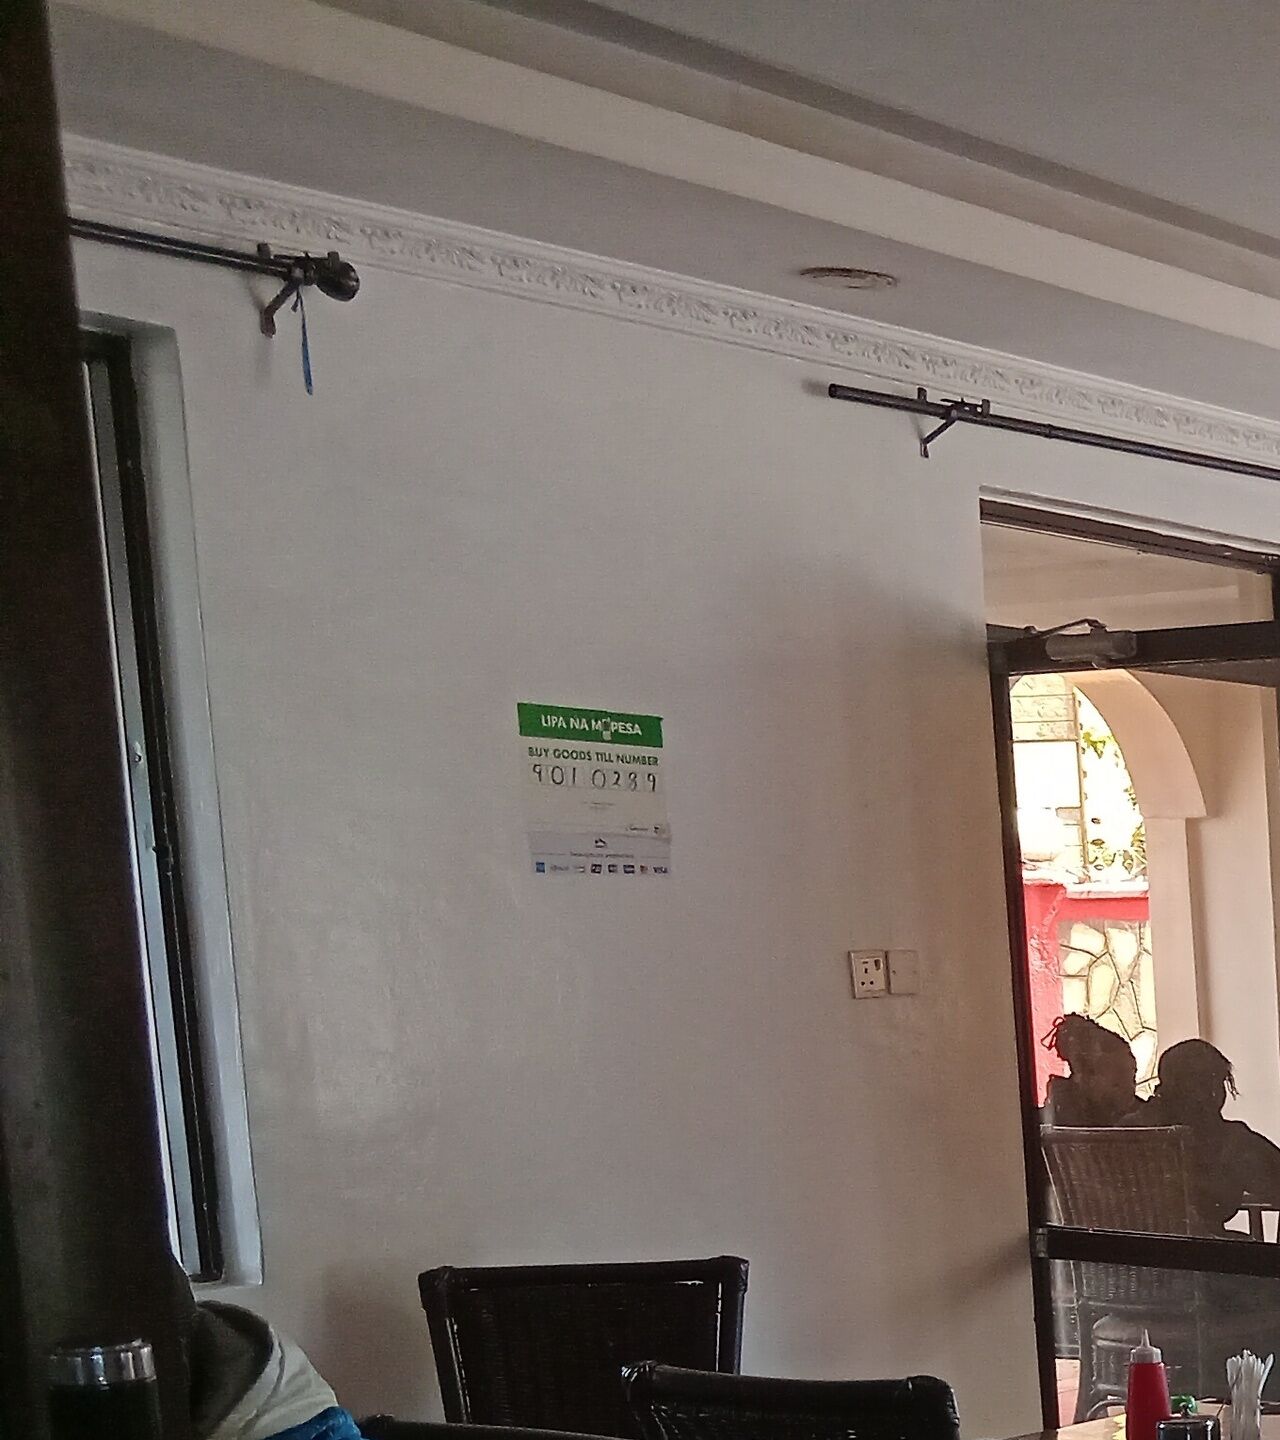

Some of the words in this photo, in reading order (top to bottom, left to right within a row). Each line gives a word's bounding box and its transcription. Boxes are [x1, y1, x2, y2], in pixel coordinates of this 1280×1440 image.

[541, 714, 567, 729] LIPA
[570, 717, 589, 731] NA
[528, 747, 549, 757] BUY
[553, 748, 592, 761] GOODS
[595, 751, 614, 763] TILL
[616, 753, 659, 766] NUMBER
